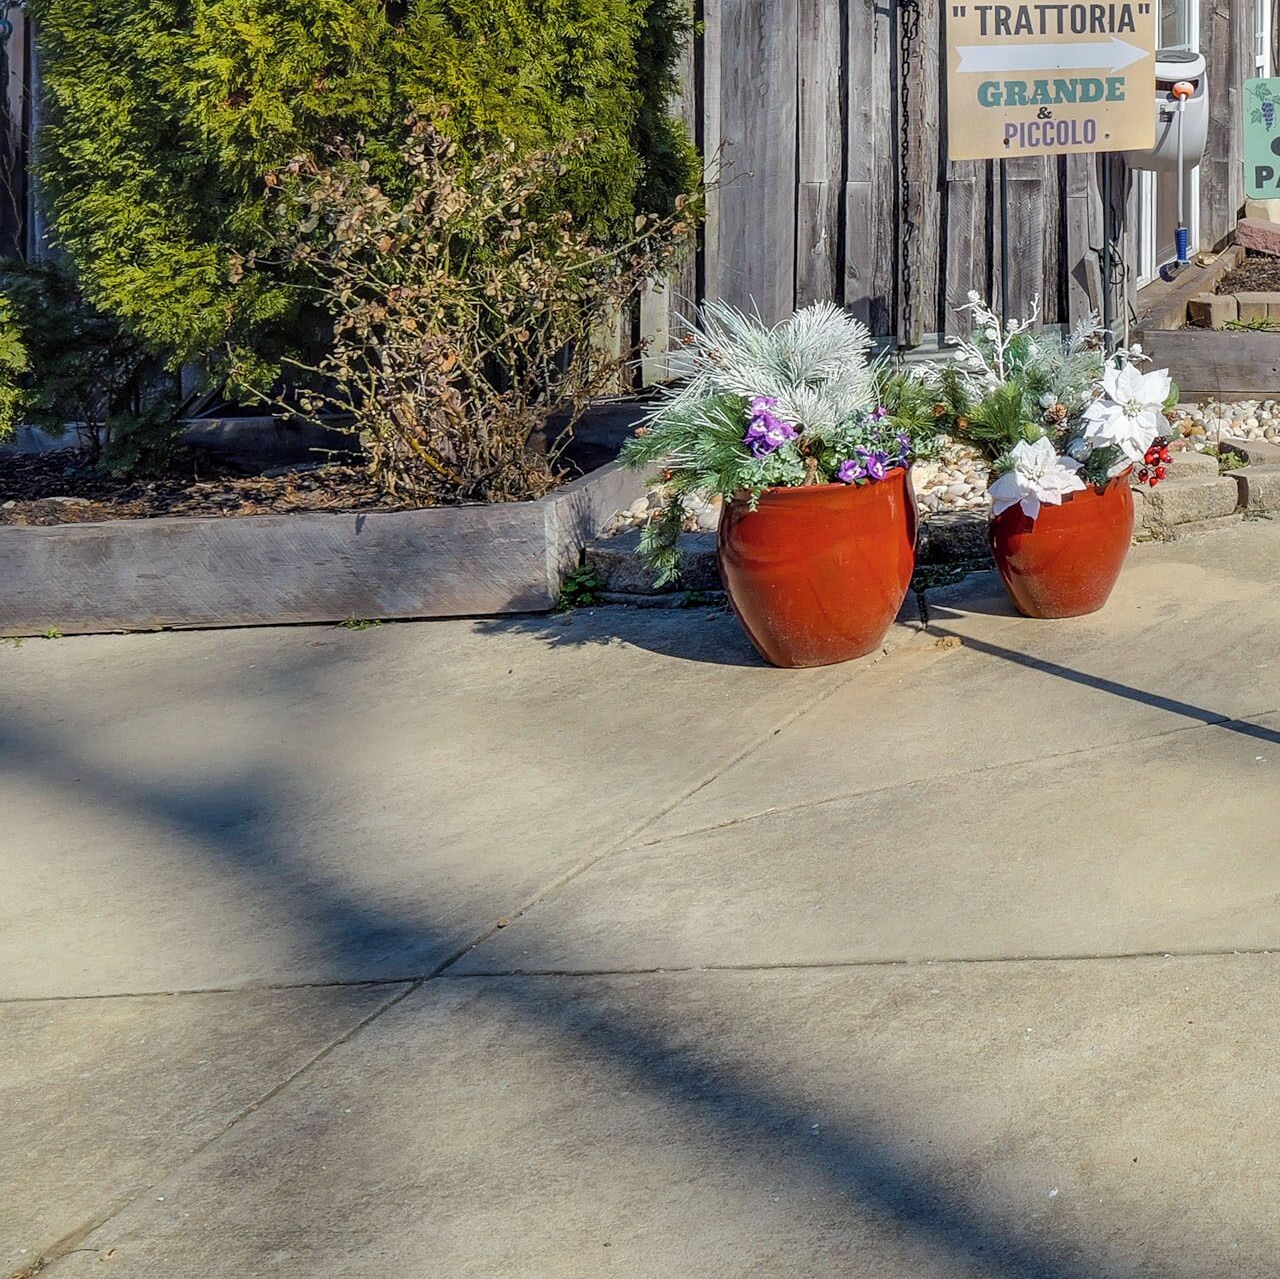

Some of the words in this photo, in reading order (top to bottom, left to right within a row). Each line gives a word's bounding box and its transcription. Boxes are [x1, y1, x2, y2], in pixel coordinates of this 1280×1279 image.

[977, 76, 1126, 108] GRANDE
[1036, 106, 1053, 120] &
[1004, 118, 1097, 149] PICCOLO
